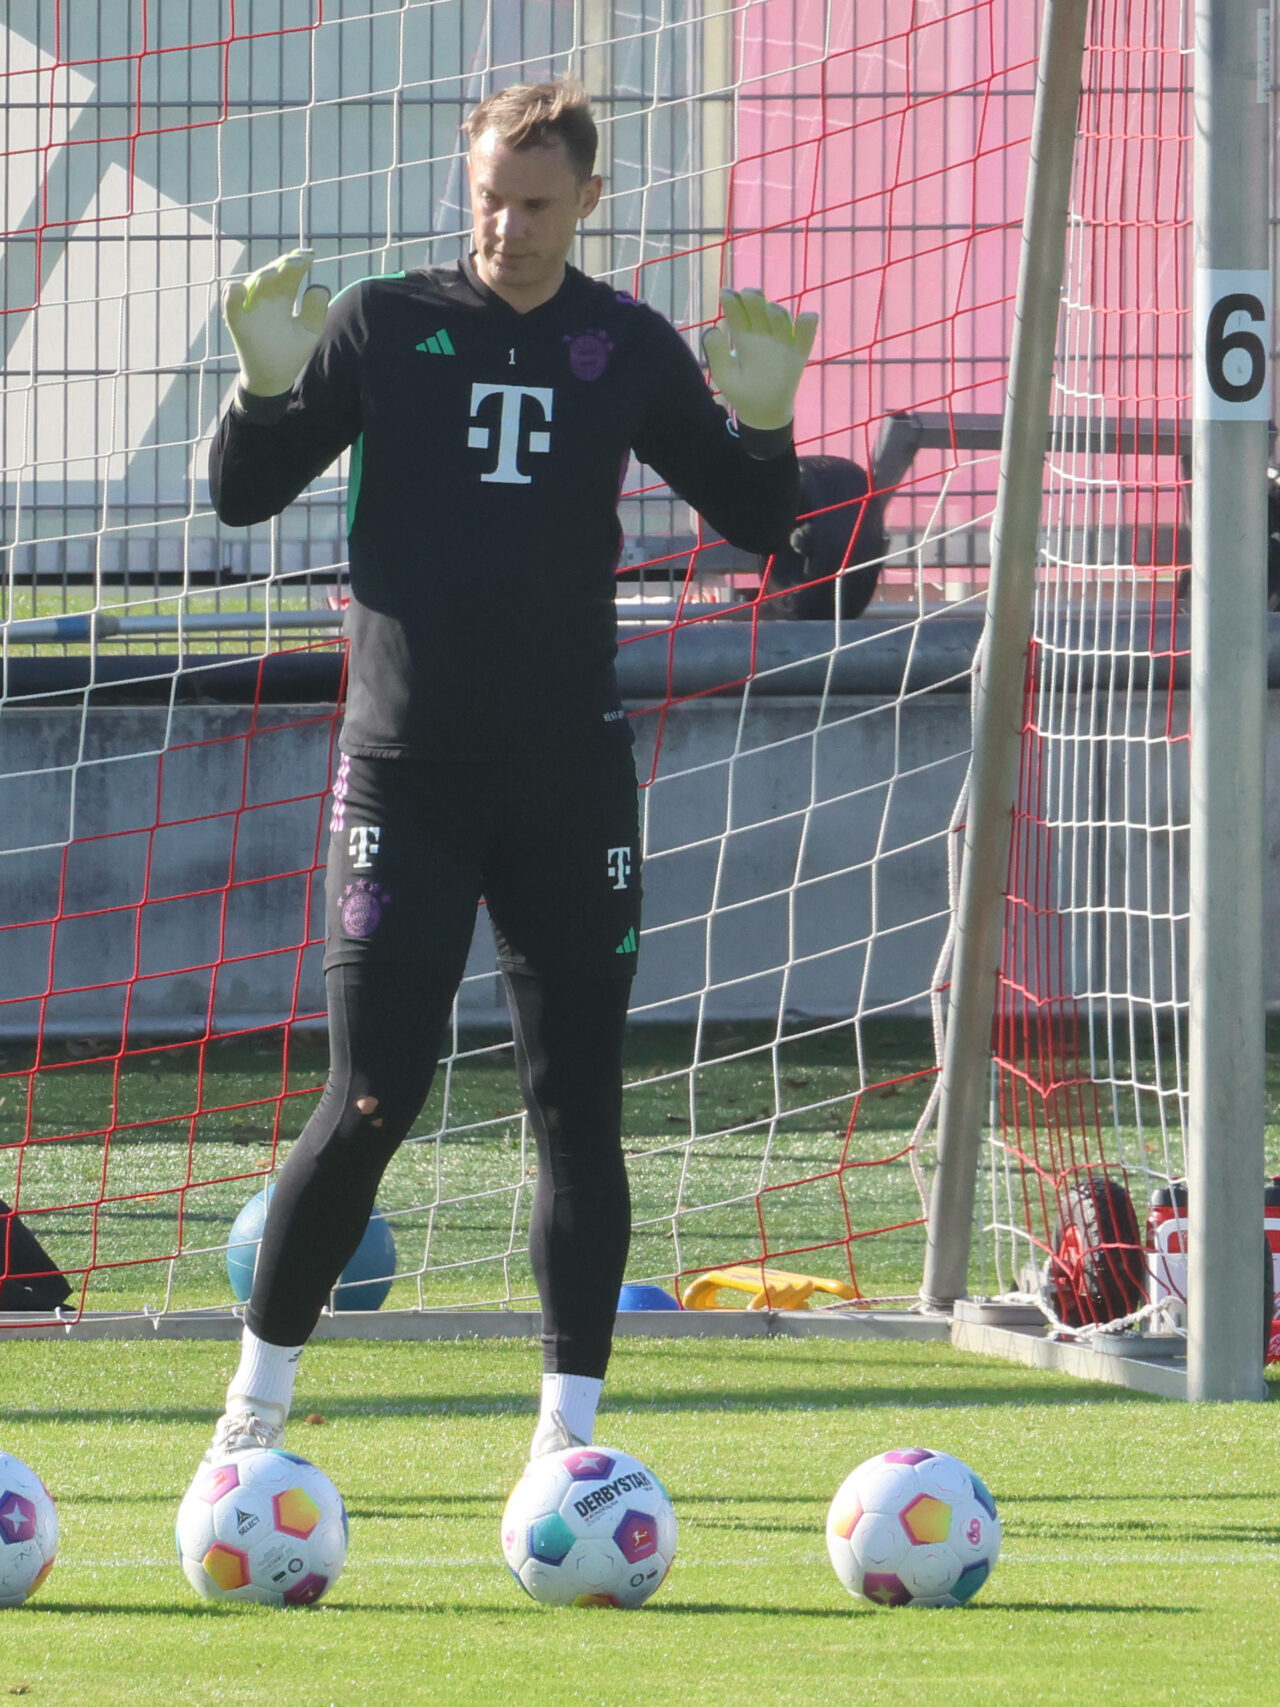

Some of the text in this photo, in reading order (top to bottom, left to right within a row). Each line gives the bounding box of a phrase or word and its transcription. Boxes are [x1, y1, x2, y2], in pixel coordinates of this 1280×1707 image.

[508, 348, 516, 365] 1
[1206, 292, 1266, 402] 6
[468, 383, 553, 484] T
[349, 827, 380, 868] T
[608, 847, 631, 890] T
[574, 1471, 651, 1518] DERBYSTAR
[238, 1516, 261, 1536] SELECT
